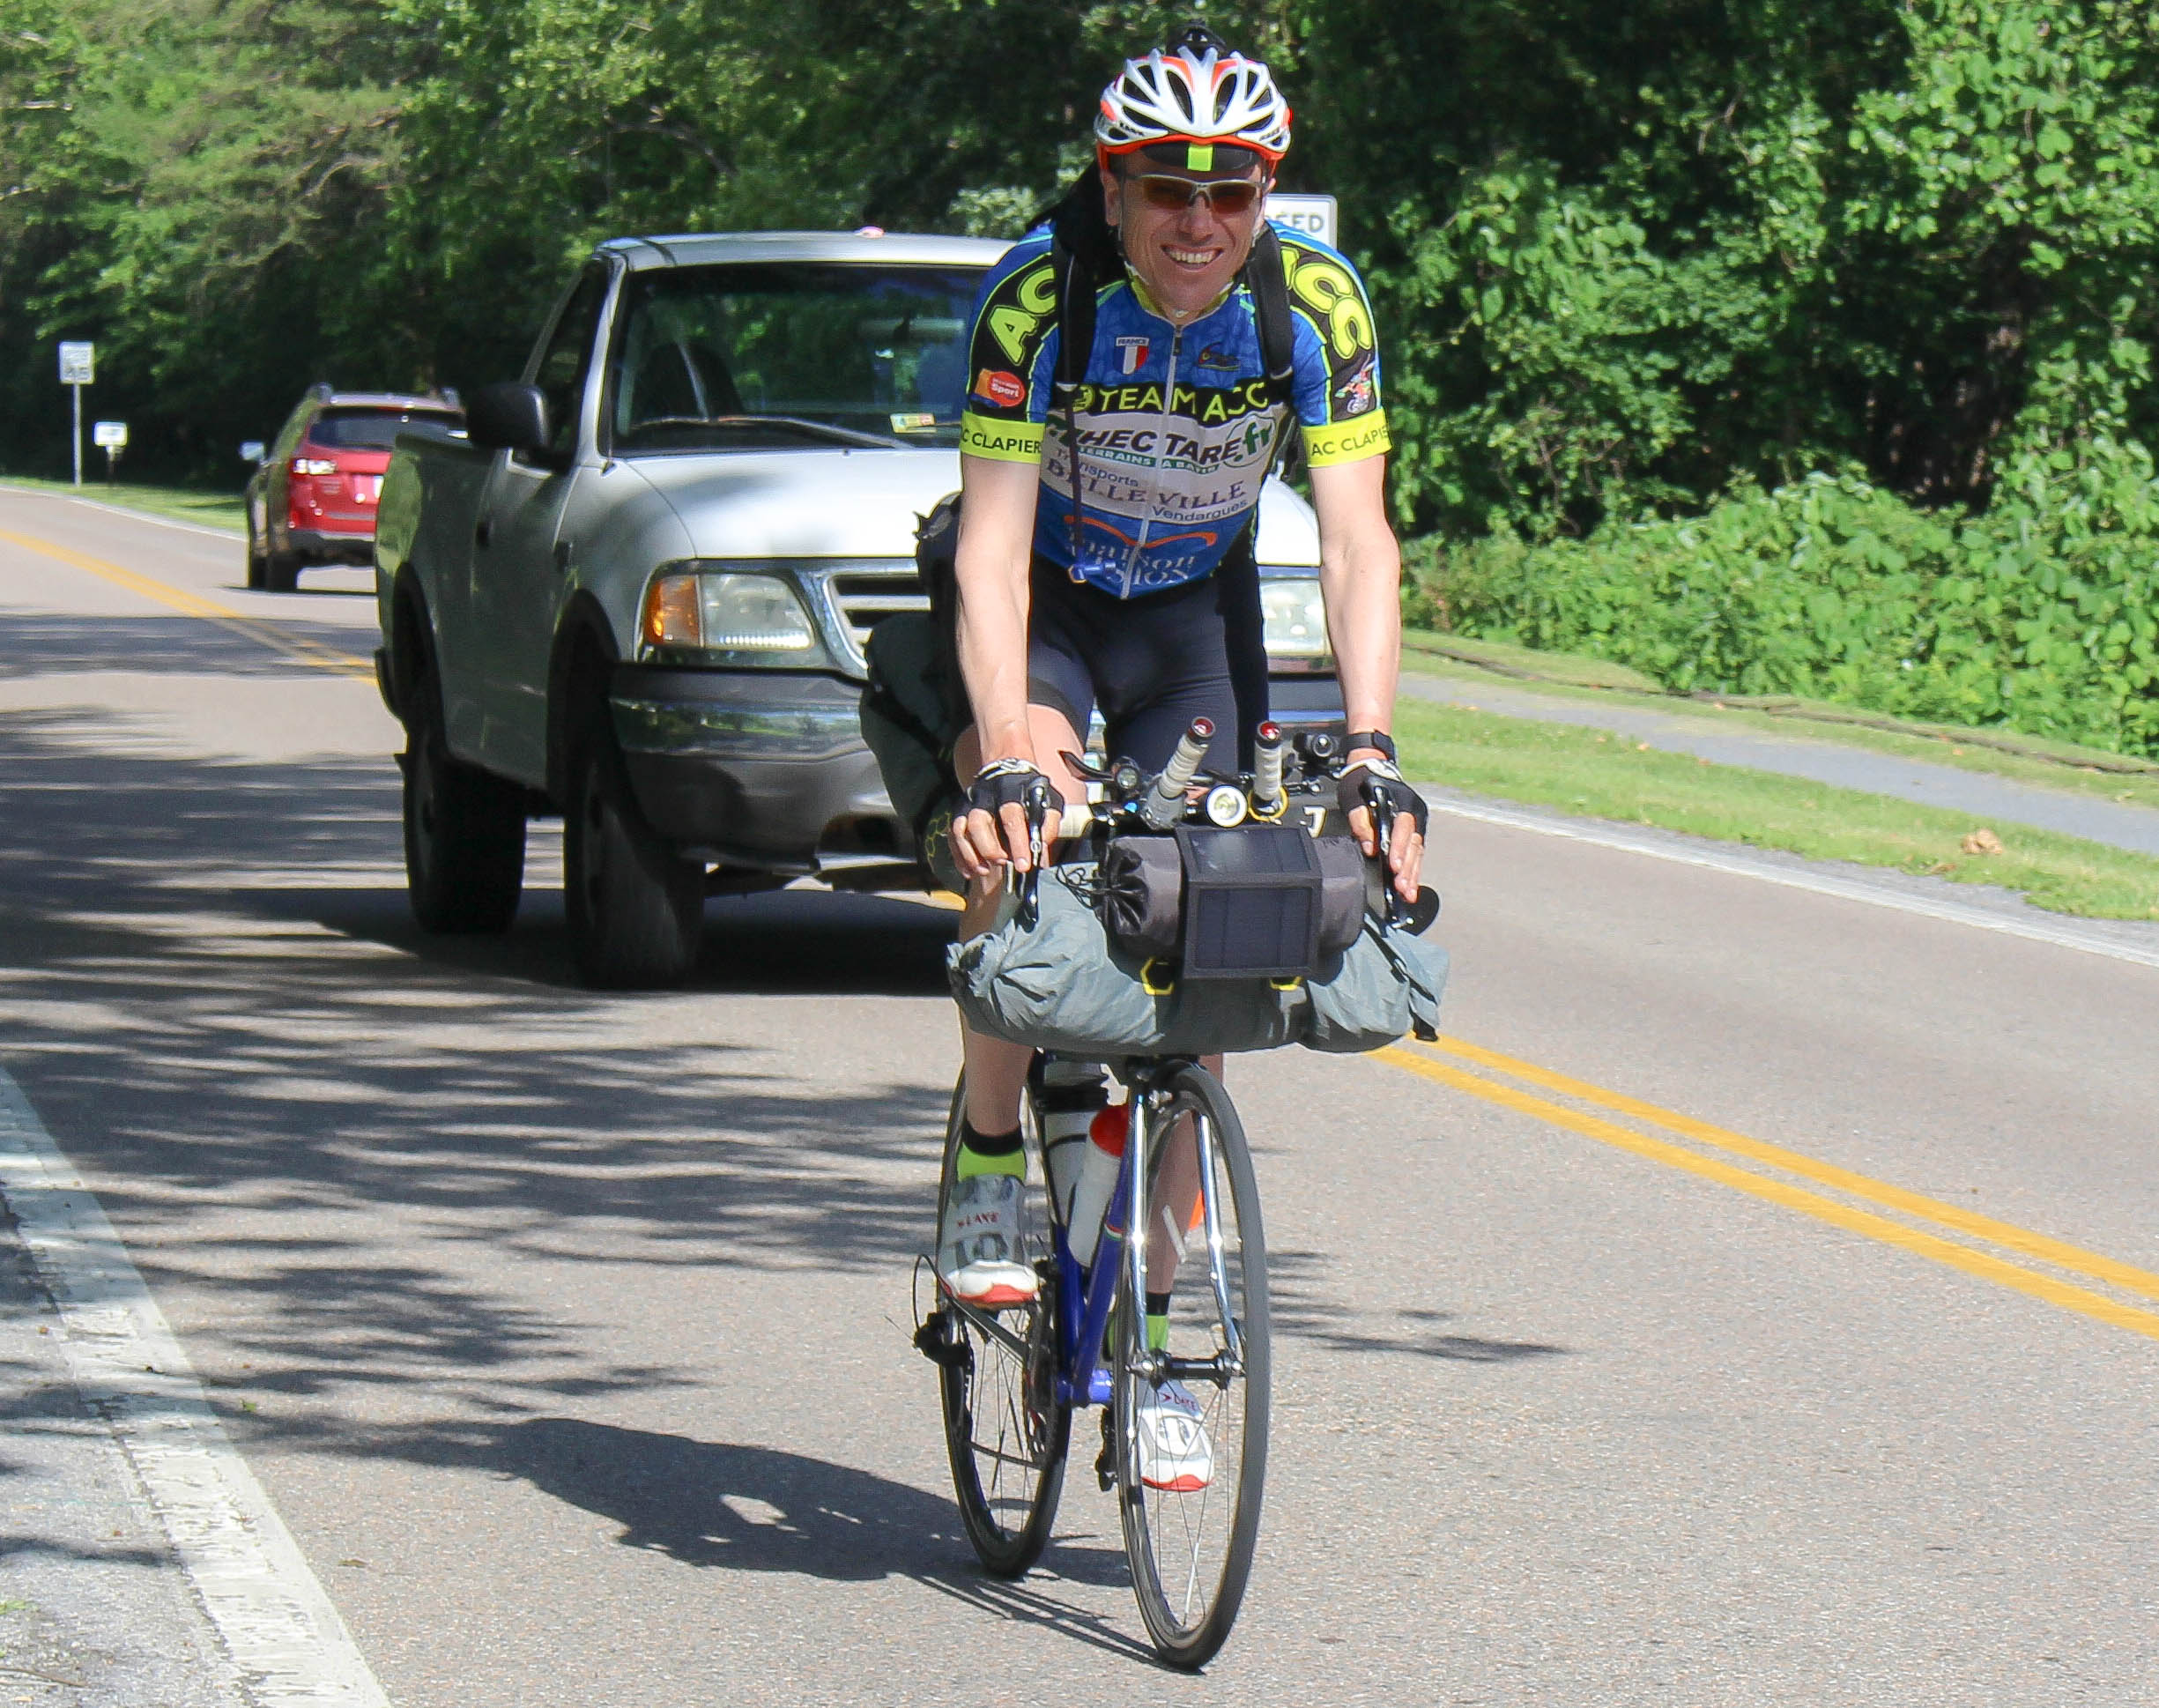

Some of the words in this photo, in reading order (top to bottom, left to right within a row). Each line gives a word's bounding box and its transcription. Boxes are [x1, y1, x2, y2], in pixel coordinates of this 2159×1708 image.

[990, 382, 1020, 397] Sport
[1099, 386, 1197, 414] TEAM
[1202, 382, 1268, 422] ACC
[1078, 446, 1153, 466] TERRAINS
[1310, 441, 1336, 457] AC
[1057, 448, 1139, 487] Trnsports
